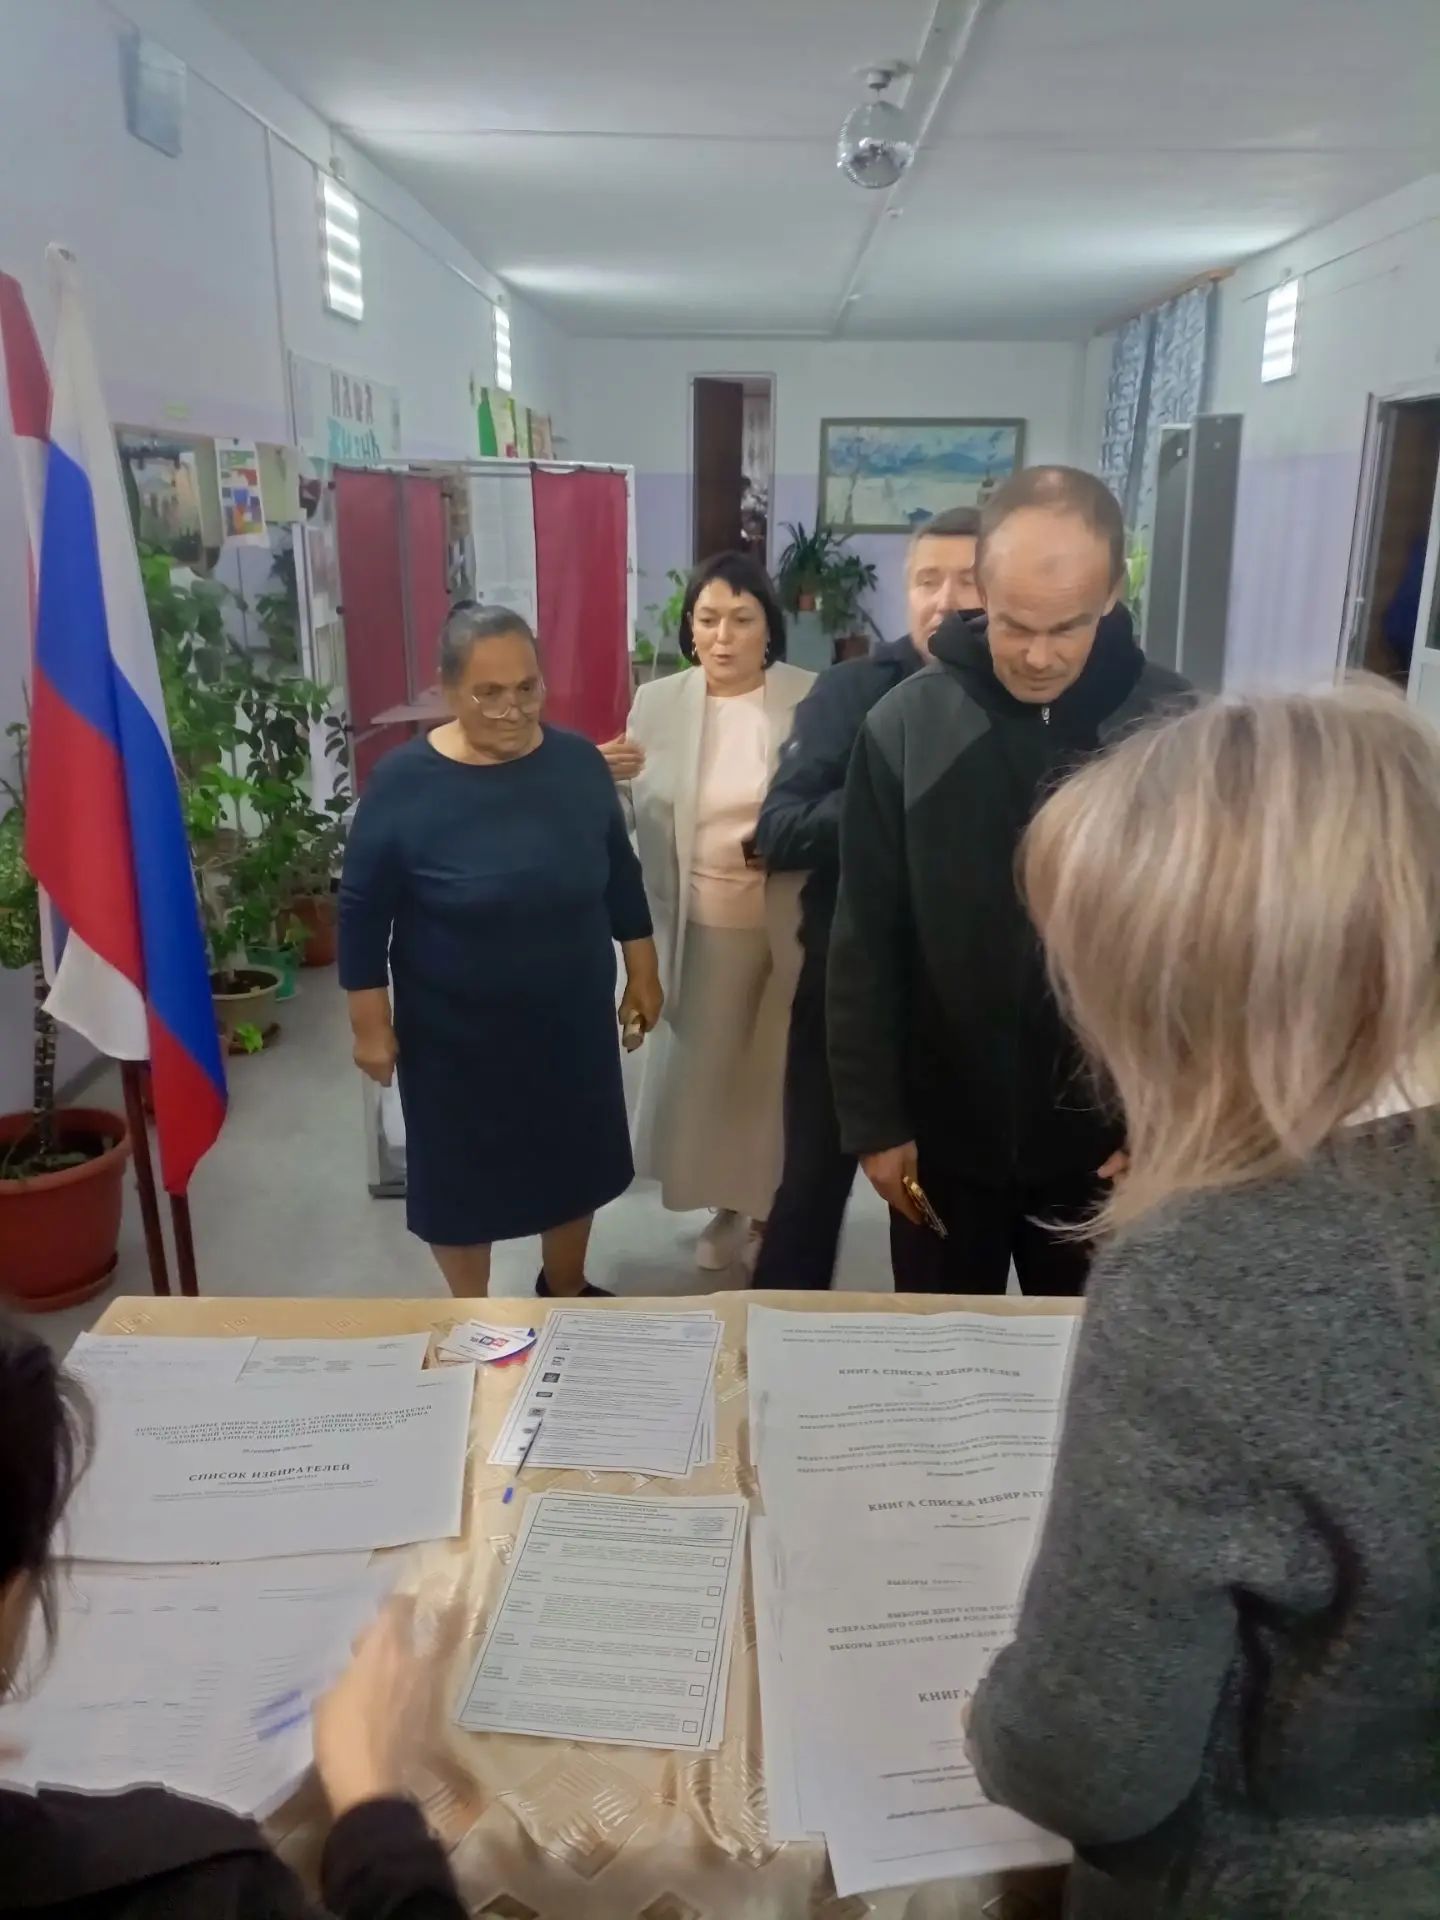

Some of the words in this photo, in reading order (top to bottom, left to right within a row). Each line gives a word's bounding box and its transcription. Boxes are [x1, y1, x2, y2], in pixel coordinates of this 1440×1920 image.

[839, 1368, 879, 1376] КНИГА
[882, 1368, 932, 1377] СПИСКА
[188, 1472, 247, 1482] СПИСОК
[251, 1463, 352, 1480] ИЗБИРАТЕЛЕЙ
[868, 1500, 915, 1512] КНИГА
[918, 1498, 975, 1509] СПИСКА
[918, 1688, 974, 1704] КНИГА
